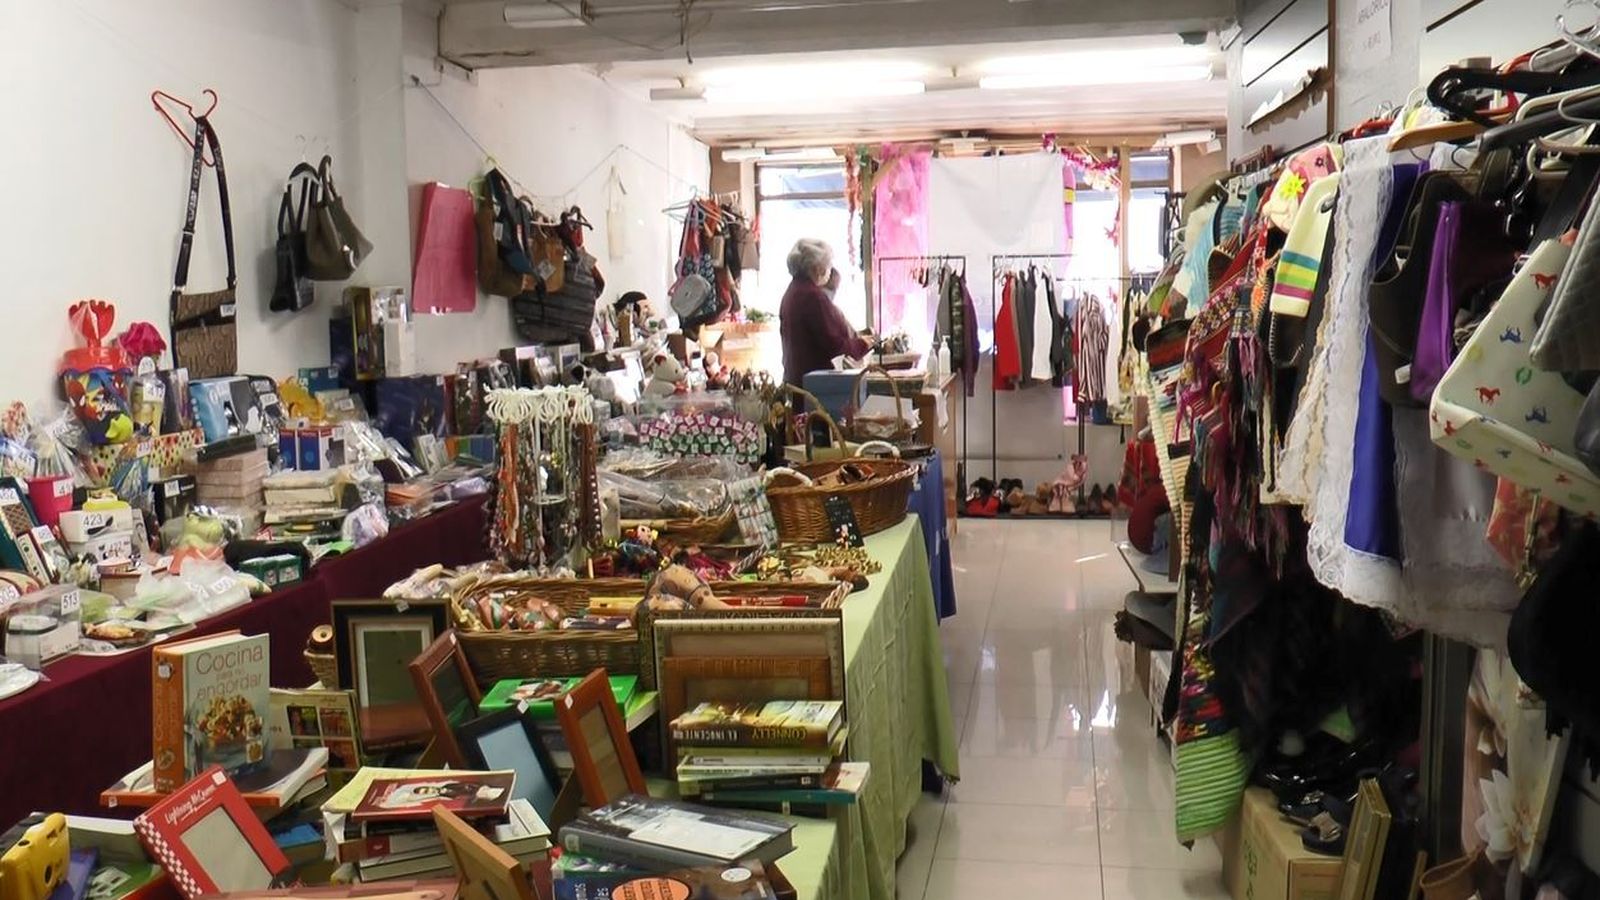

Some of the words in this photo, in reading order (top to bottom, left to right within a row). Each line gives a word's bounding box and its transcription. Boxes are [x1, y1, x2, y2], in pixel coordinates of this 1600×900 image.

[83, 512, 103, 526] 423
[62, 593, 79, 609] 513
[196, 645, 263, 675] Cocina
[196, 673, 263, 701] engordar
[752, 726, 808, 740] CONNELLY
